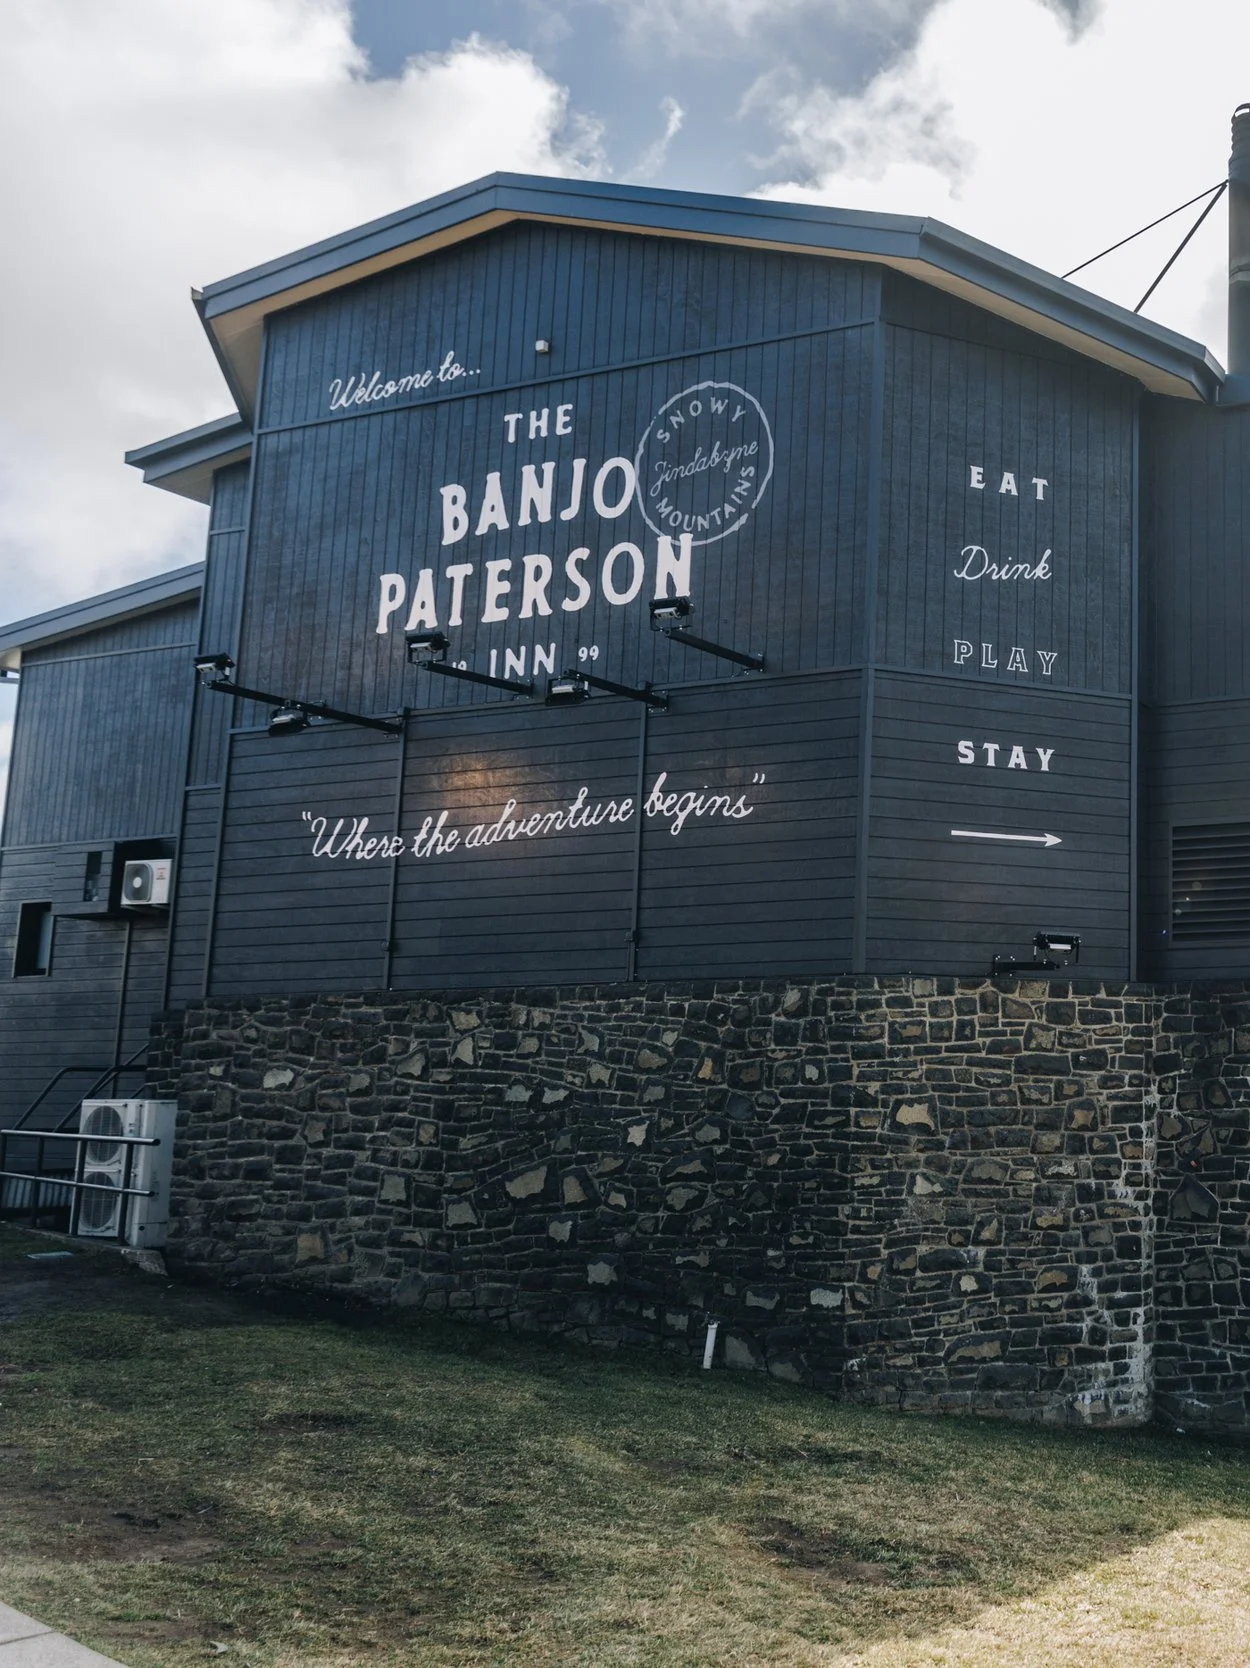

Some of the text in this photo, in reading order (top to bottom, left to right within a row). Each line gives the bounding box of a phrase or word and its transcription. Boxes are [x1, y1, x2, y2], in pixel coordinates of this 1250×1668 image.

[328, 369, 434, 411] Welcome
[503, 403, 573, 443] THE
[657, 396, 746, 443] SNOWY
[649, 440, 759, 497] Jindabyne
[969, 465, 1049, 501] EAT
[439, 456, 636, 546] BANJO
[656, 466, 755, 532] MOUNTAINS
[375, 532, 694, 634] PATERSON
[953, 545, 1053, 581] Drink
[489, 642, 556, 680] INN
[953, 639, 1058, 676] PLAY
[957, 740, 1056, 772] STAY
[410, 810, 461, 858] the
[464, 786, 635, 849] adventure
